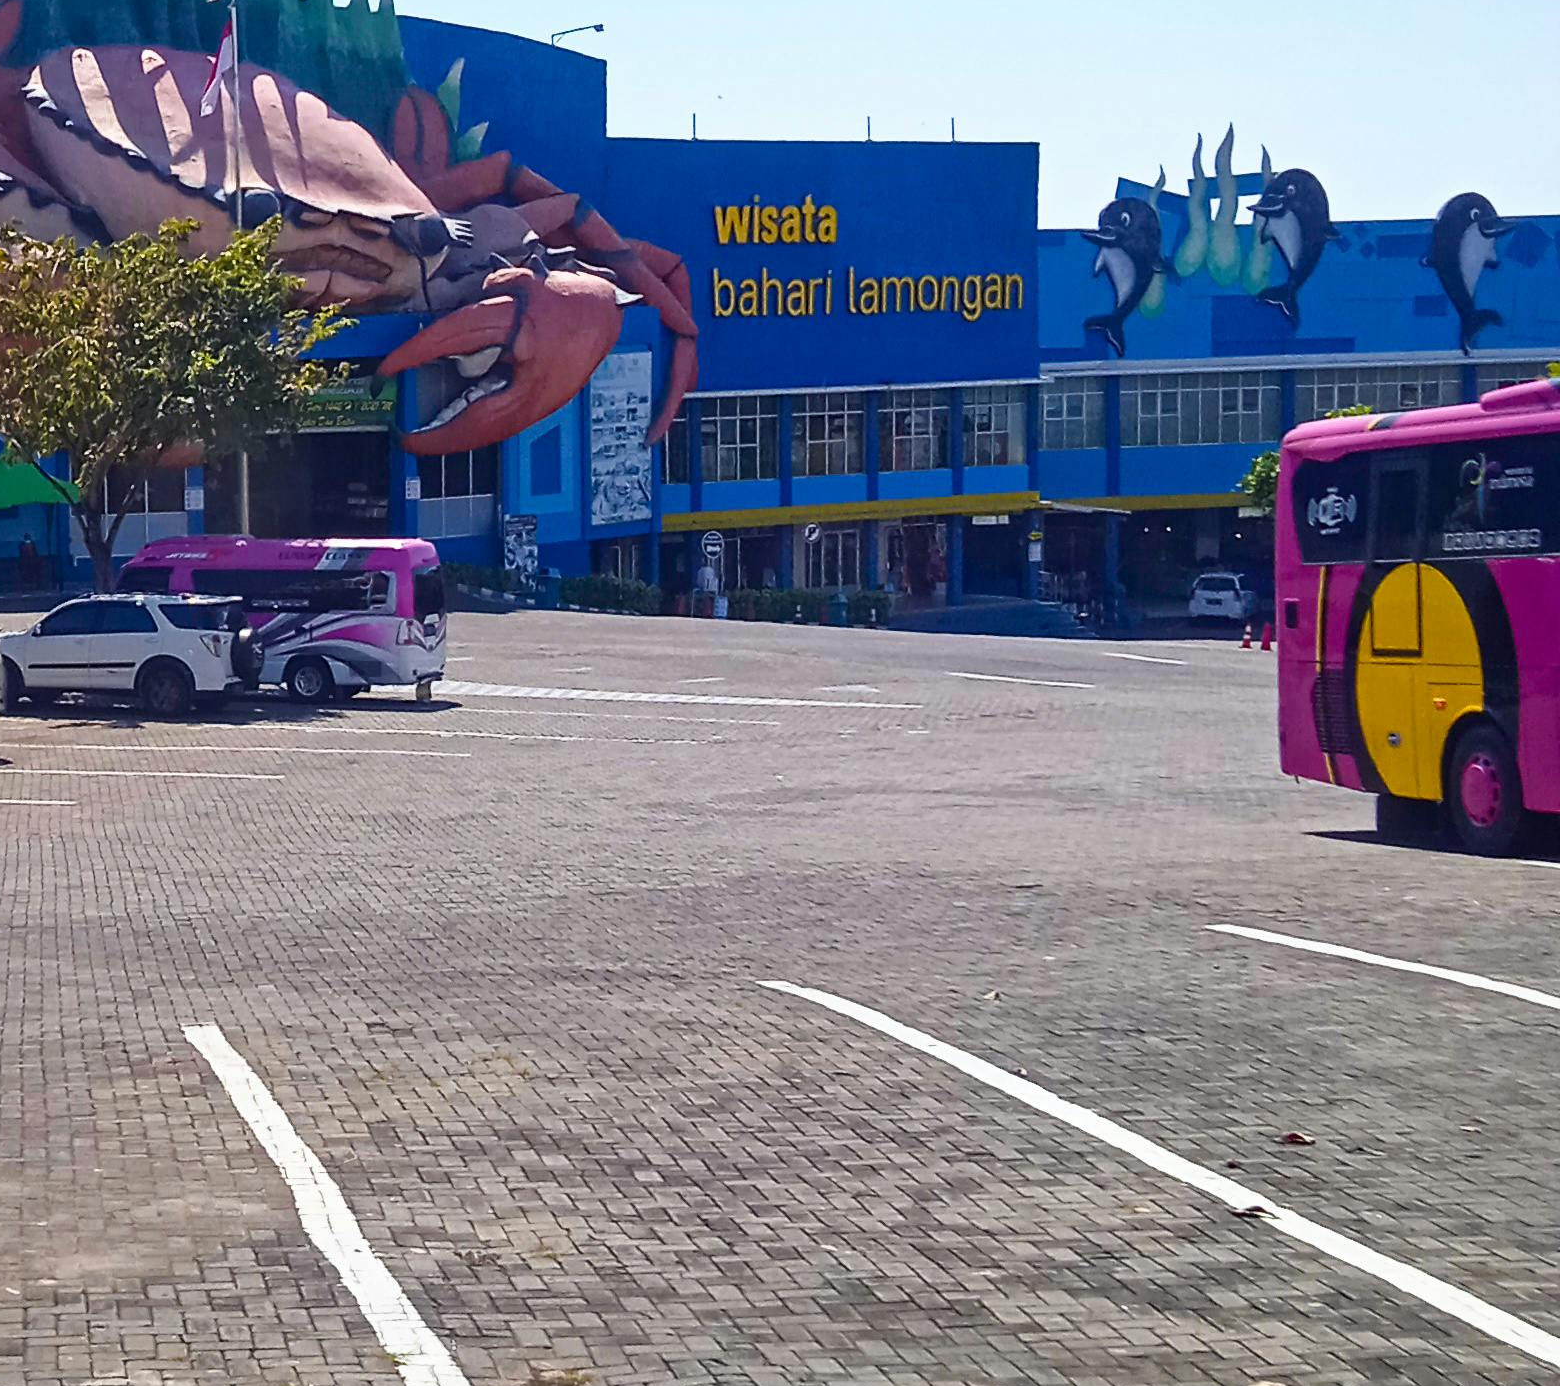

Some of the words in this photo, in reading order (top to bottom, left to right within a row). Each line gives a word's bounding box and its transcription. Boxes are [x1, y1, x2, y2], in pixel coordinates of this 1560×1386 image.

[714, 194, 837, 245] wisata
[714, 267, 833, 317] bahari
[849, 266, 1023, 321] lamongan
